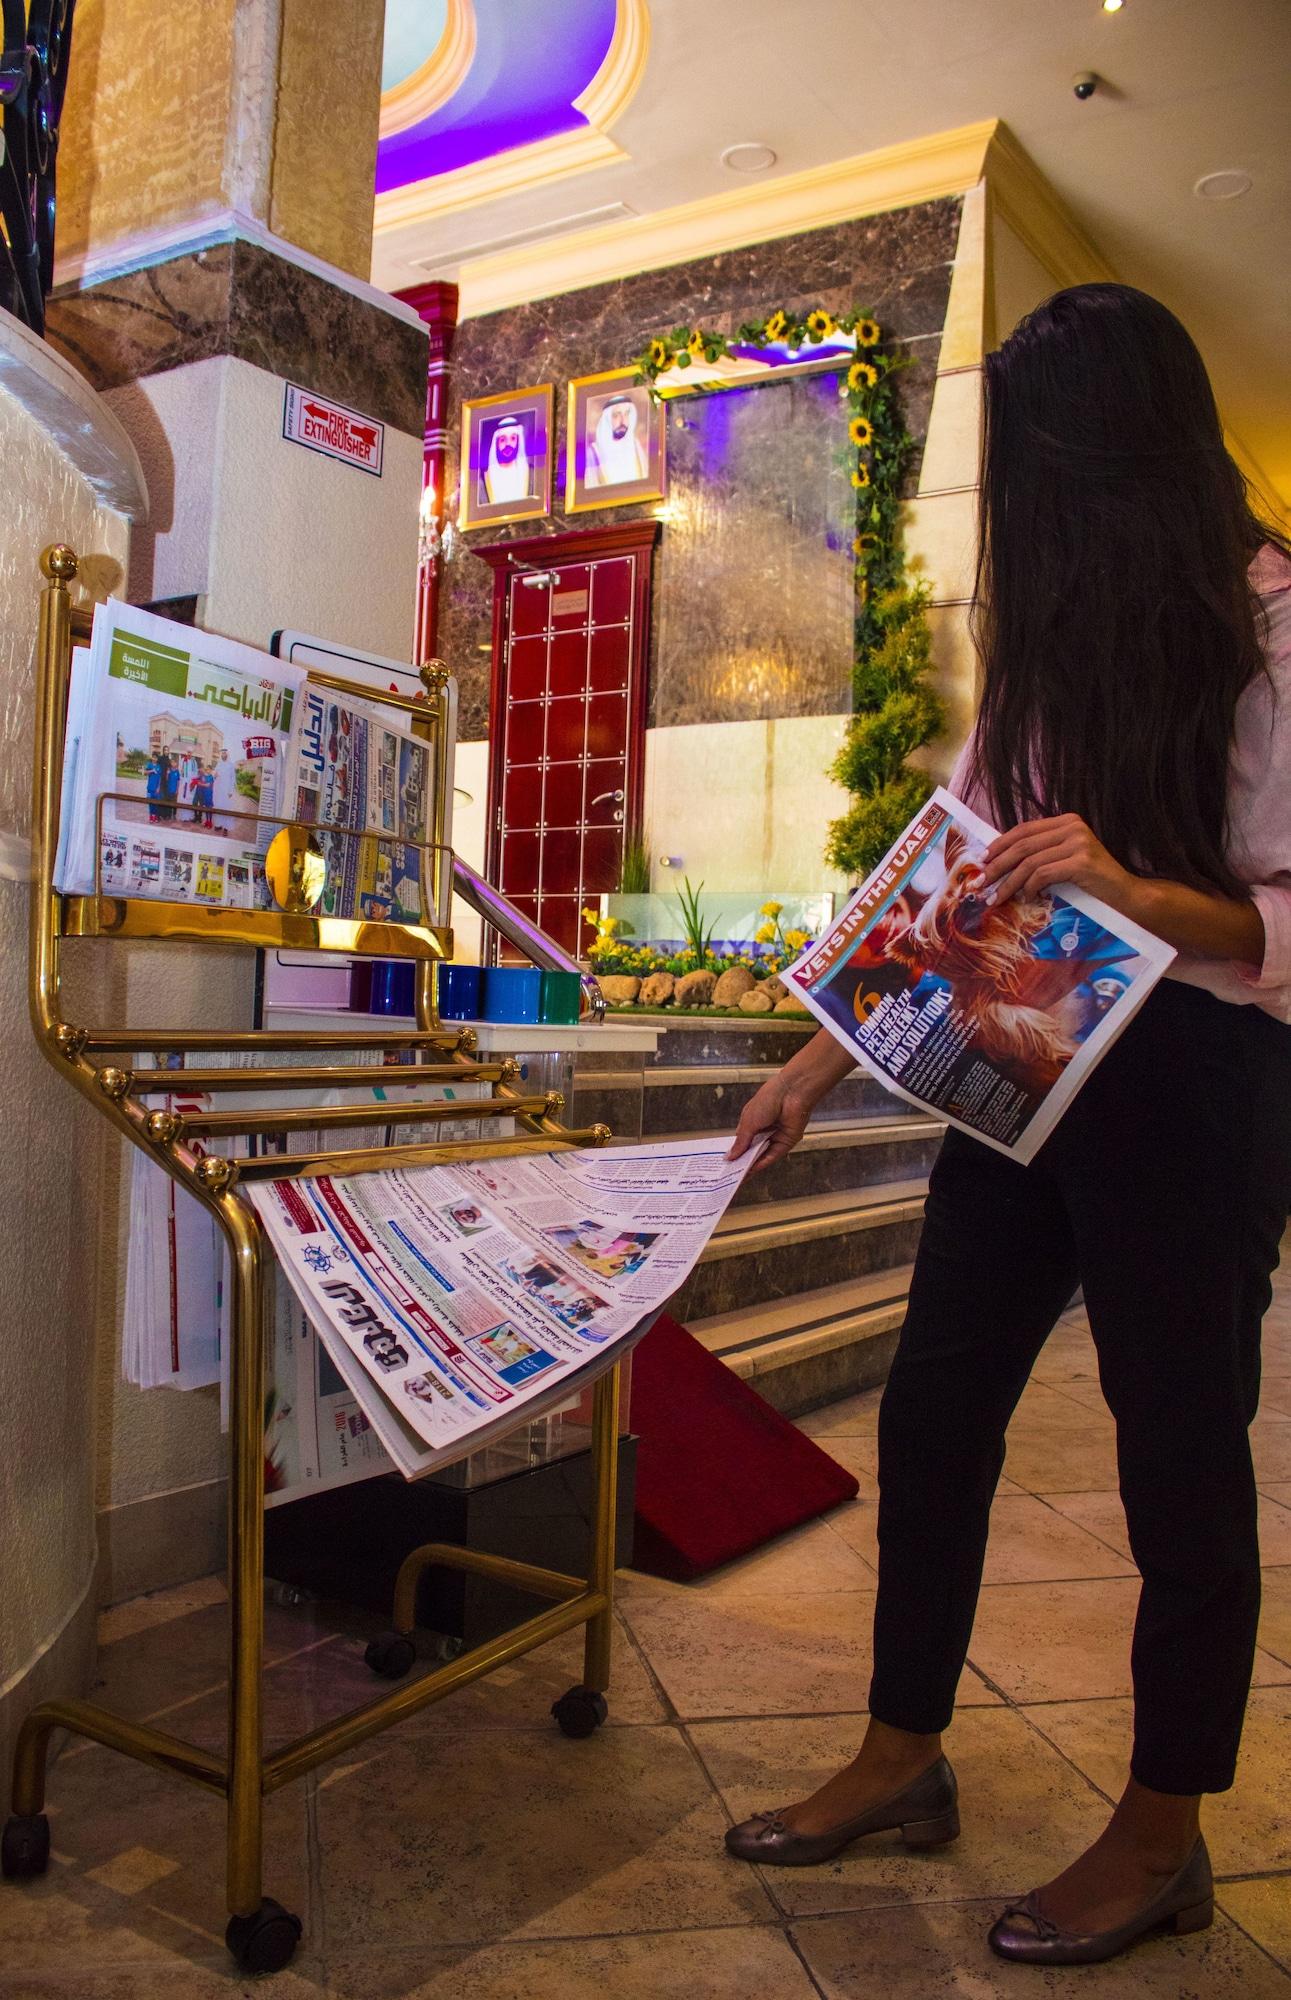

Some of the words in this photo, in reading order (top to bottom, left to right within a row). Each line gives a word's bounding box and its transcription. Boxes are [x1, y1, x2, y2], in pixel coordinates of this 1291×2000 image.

[304, 418, 371, 461] EXTINGUISHER
[329, 412, 349, 433] FIRE
[121, 652, 150, 669] اللمسة
[187, 681, 273, 722] الرياضي
[249, 737, 272, 752] BIG
[299, 693, 324, 771] الدليل
[795, 928, 846, 985] VETS
[841, 907, 865, 933] IN
[858, 866, 897, 911] THE
[891, 823, 929, 869] UAE
[853, 981, 881, 1026] 6
[853, 992, 896, 1043] COMMON
[863, 1026, 887, 1054] PET
[878, 987, 913, 1033] HEALTH
[873, 1001, 920, 1065] PROBLEMS
[884, 1045, 912, 1076] AND
[900, 986, 954, 1052] SOLUTIONS
[904, 1067, 913, 1078] The
[911, 1056, 921, 1068] UAE
[924, 1031, 939, 1048] nation
[940, 1007, 956, 1027] animal
[917, 1061, 926, 1071] but
[923, 1052, 932, 1062] the
[929, 1033, 946, 1053] climate
[943, 1023, 953, 1034] and
[950, 1007, 965, 1025] tough
[924, 1041, 949, 1074] environment
[946, 1032, 956, 1043] can
[953, 1021, 964, 1034] play
[945, 1055, 957, 1069] what
[958, 1037, 969, 1050] look
[928, 1068, 938, 1081] with
[936, 1058, 947, 1070] your
[943, 1045, 955, 1058] furry
[376, 1237, 392, 1255] اليوم
[333, 1411, 346, 1430] 2016
